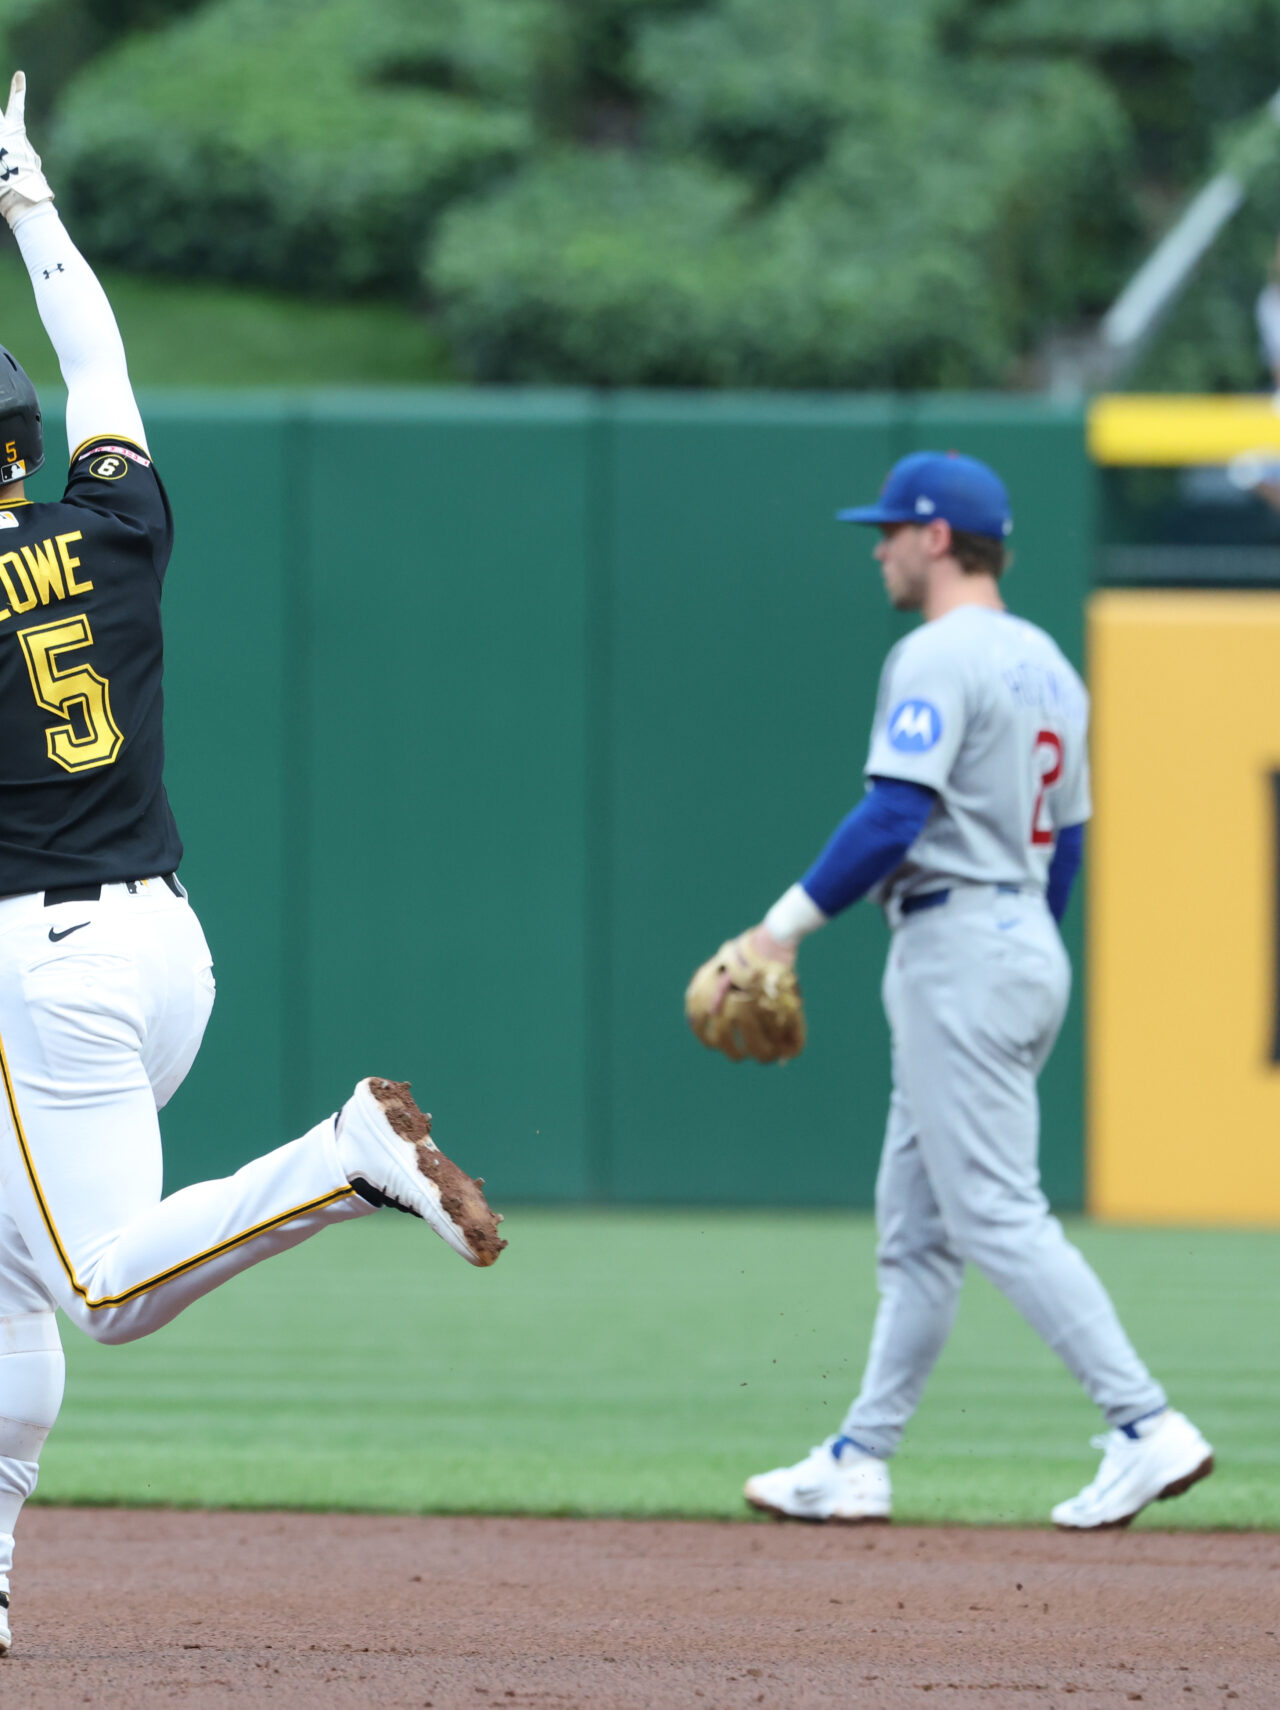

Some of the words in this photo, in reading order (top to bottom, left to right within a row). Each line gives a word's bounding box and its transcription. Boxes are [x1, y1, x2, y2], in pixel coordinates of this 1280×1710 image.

[5, 440, 18, 463] 5
[17, 613, 125, 774] 5
[1030, 730, 1063, 845] 2
